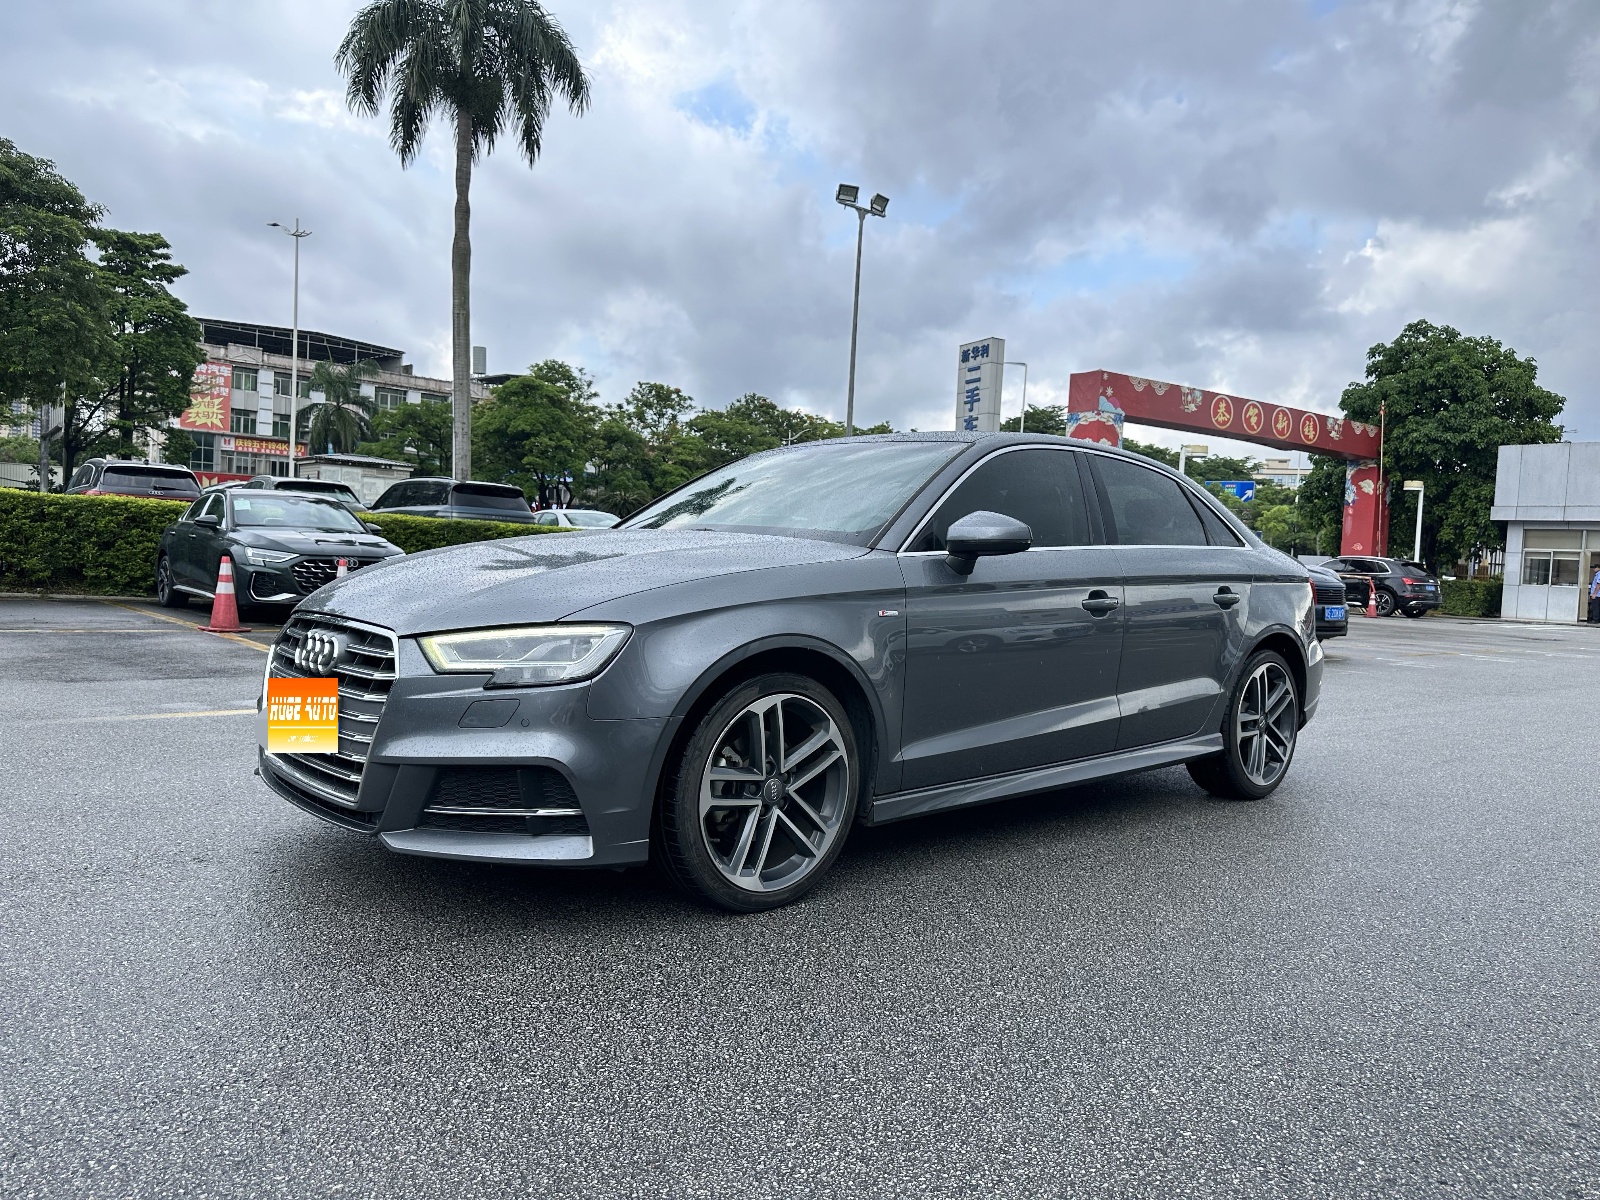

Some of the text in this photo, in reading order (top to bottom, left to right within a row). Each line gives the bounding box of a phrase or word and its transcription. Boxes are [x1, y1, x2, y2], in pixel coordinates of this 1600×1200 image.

[961, 344, 990, 363] 新华利
[964, 366, 981, 431] 二手车
[193, 411, 219, 419] 大马力
[1215, 400, 1315, 439] 恭贺新禧
[235, 438, 305, 453] 庆铃五十铃4K力
